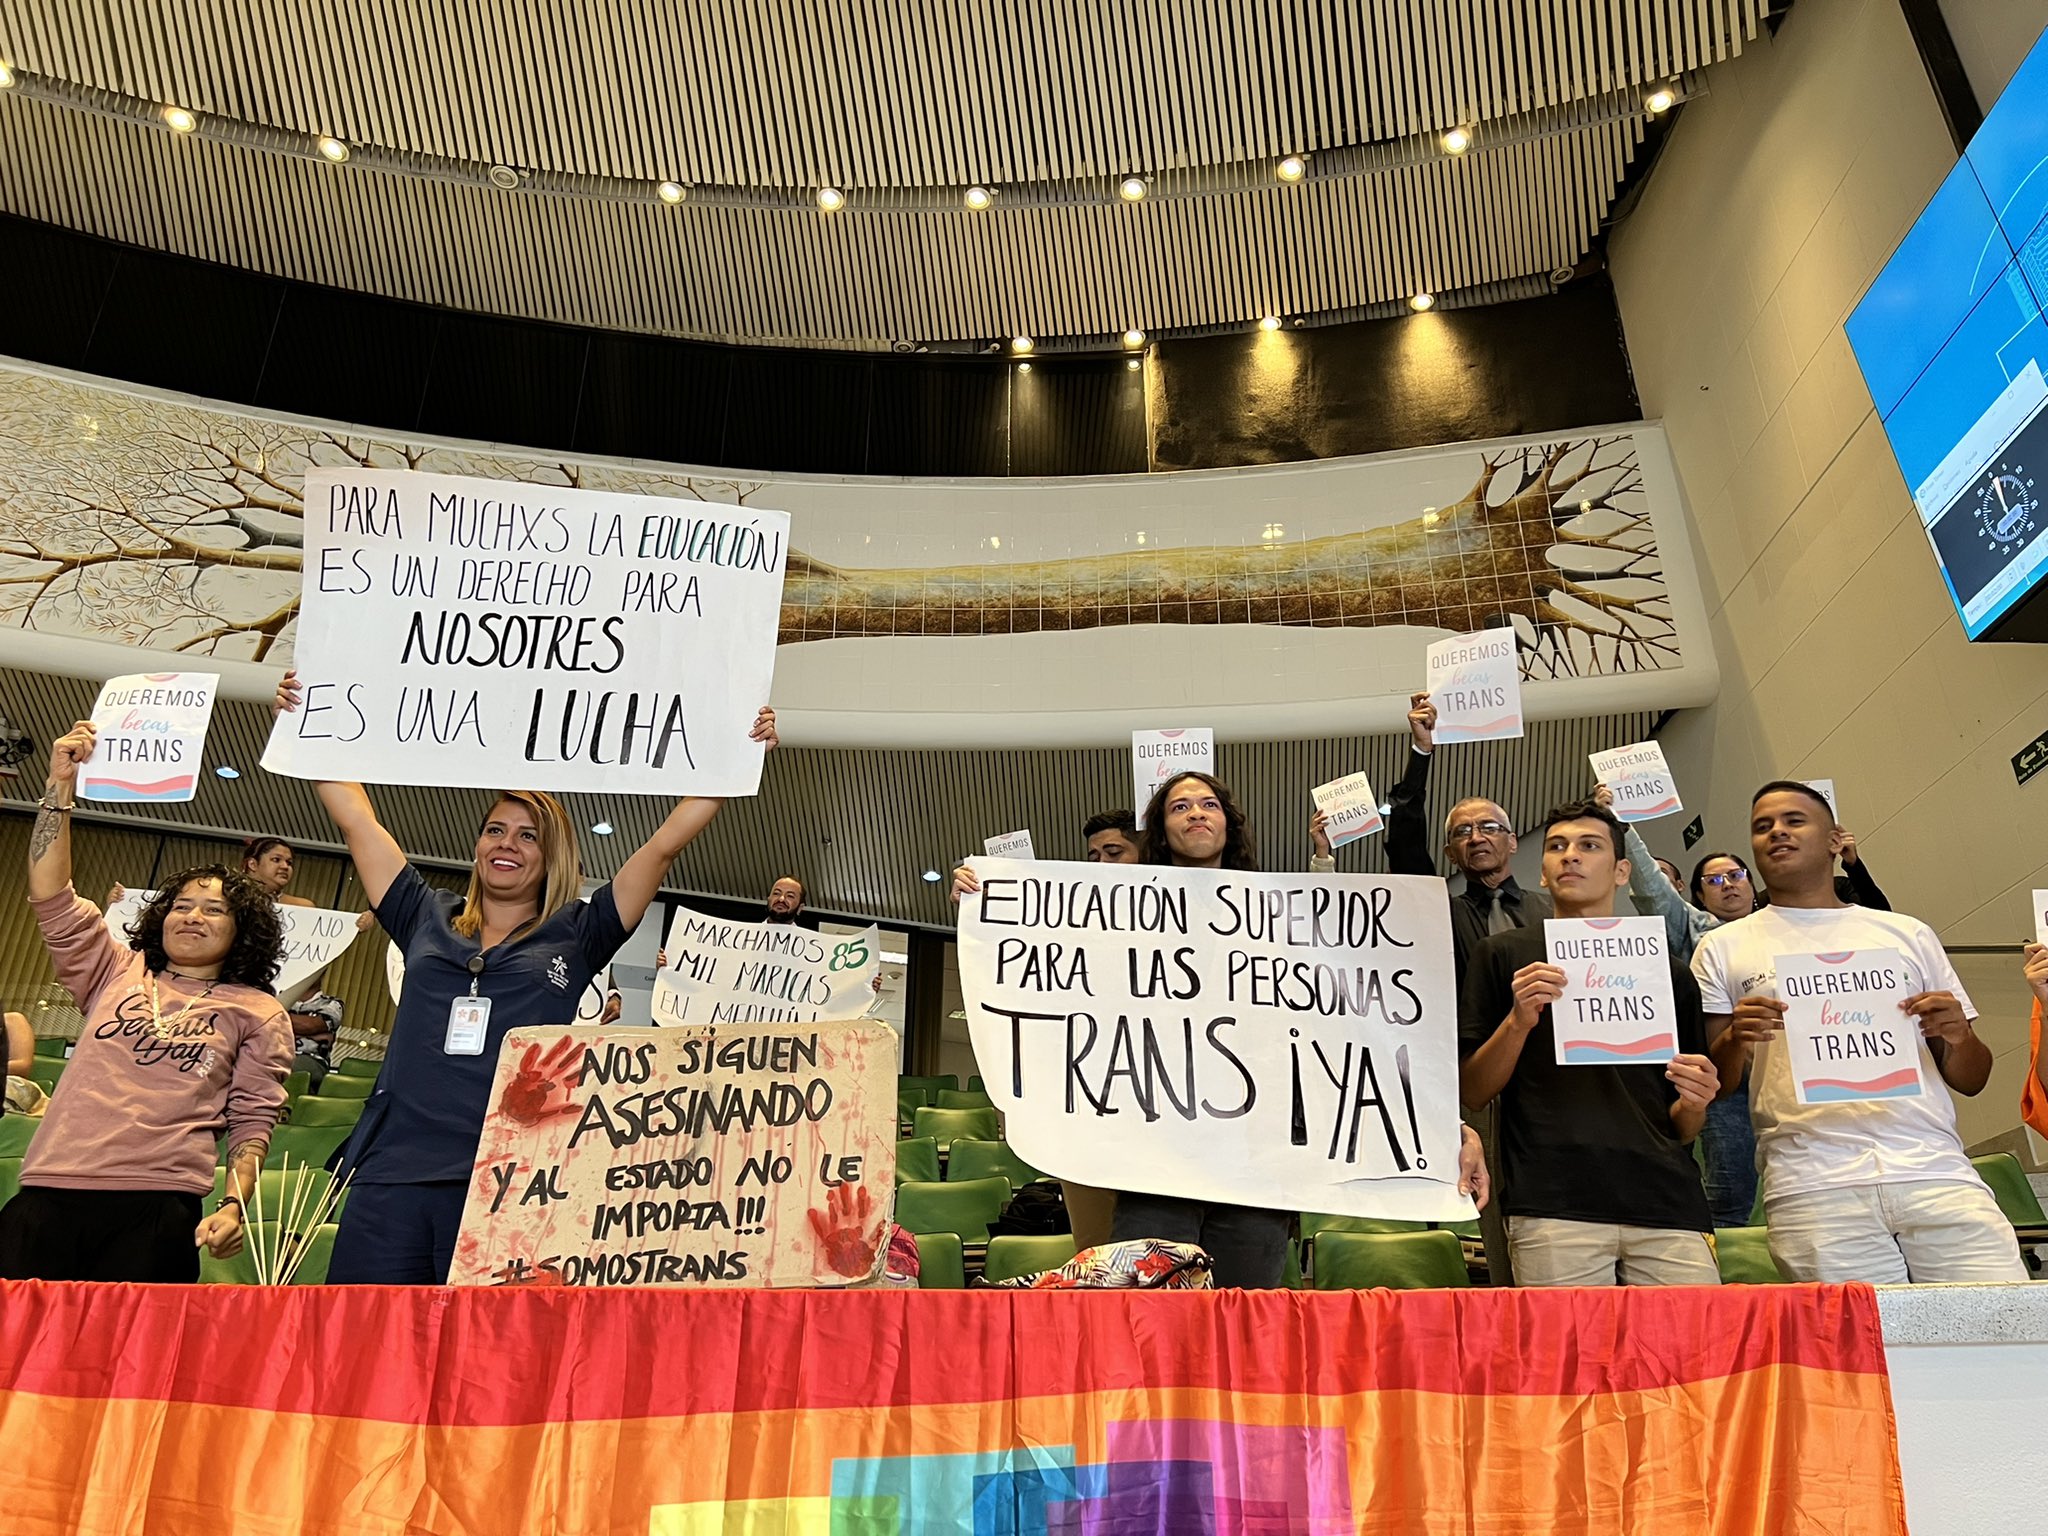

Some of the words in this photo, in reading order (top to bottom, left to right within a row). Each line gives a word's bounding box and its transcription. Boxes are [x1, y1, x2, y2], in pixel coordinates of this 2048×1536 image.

[329, 483, 402, 539] PARA
[429, 491, 570, 552] MUCHXS
[589, 512, 624, 558] LA
[638, 514, 780, 575] EDUCACIÓN
[319, 547, 371, 596] ES
[392, 555, 437, 600] UN
[457, 558, 591, 607] DERECHO
[622, 569, 702, 618] PARA
[400, 610, 624, 674] NOSOTRES
[1432, 641, 1509, 669] QUEREMOS
[1452, 666, 1492, 686] becas
[105, 689, 207, 708] QUEREMOS
[1443, 687, 1505, 712] TRANS
[120, 708, 174, 733] becas
[298, 682, 366, 742] ES
[397, 686, 487, 747] UNA
[524, 687, 696, 771] LUCHA
[104, 738, 183, 762] TRANS
[1138, 741, 1208, 758] QUEREMOS
[1598, 750, 1660, 772] QUEREMOS
[1156, 760, 1189, 777] bec
[1317, 779, 1365, 803] QUEREMOS
[1615, 780, 1664, 801] TRANS
[1331, 803, 1369, 826] TRANS
[988, 838, 1029, 856] QUEREMOS
[979, 876, 1187, 934] EDUCACIÓN
[1207, 884, 1414, 949] SUPERIOR
[311, 916, 343, 938] NO
[683, 918, 824, 963] MARCHAMOS
[828, 938, 869, 972] 85
[1555, 936, 1659, 960] QUEREMOS
[675, 949, 718, 984] MIL
[733, 961, 832, 1006] MARICAS
[996, 938, 1096, 997] PARA
[1129, 947, 1201, 1000] LAS
[1228, 950, 1422, 1026] PERSONAS
[1585, 962, 1638, 990] becas
[1786, 969, 1896, 997] QUEREMOS
[660, 990, 689, 1020] EN
[1573, 995, 1655, 1023] TRANS
[1821, 999, 1875, 1026] becas
[133, 1036, 206, 1072] Day
[1809, 1031, 1896, 1061] TRANS
[577, 1042, 657, 1087] NOS
[980, 1002, 1256, 1122] TRANS
[567, 1079, 833, 1149] ASESINANDO
[489, 1164, 511, 1213] Y
[519, 1164, 568, 1206] AL
[605, 1156, 712, 1191] ESTADO
[819, 1155, 863, 1187] LE
